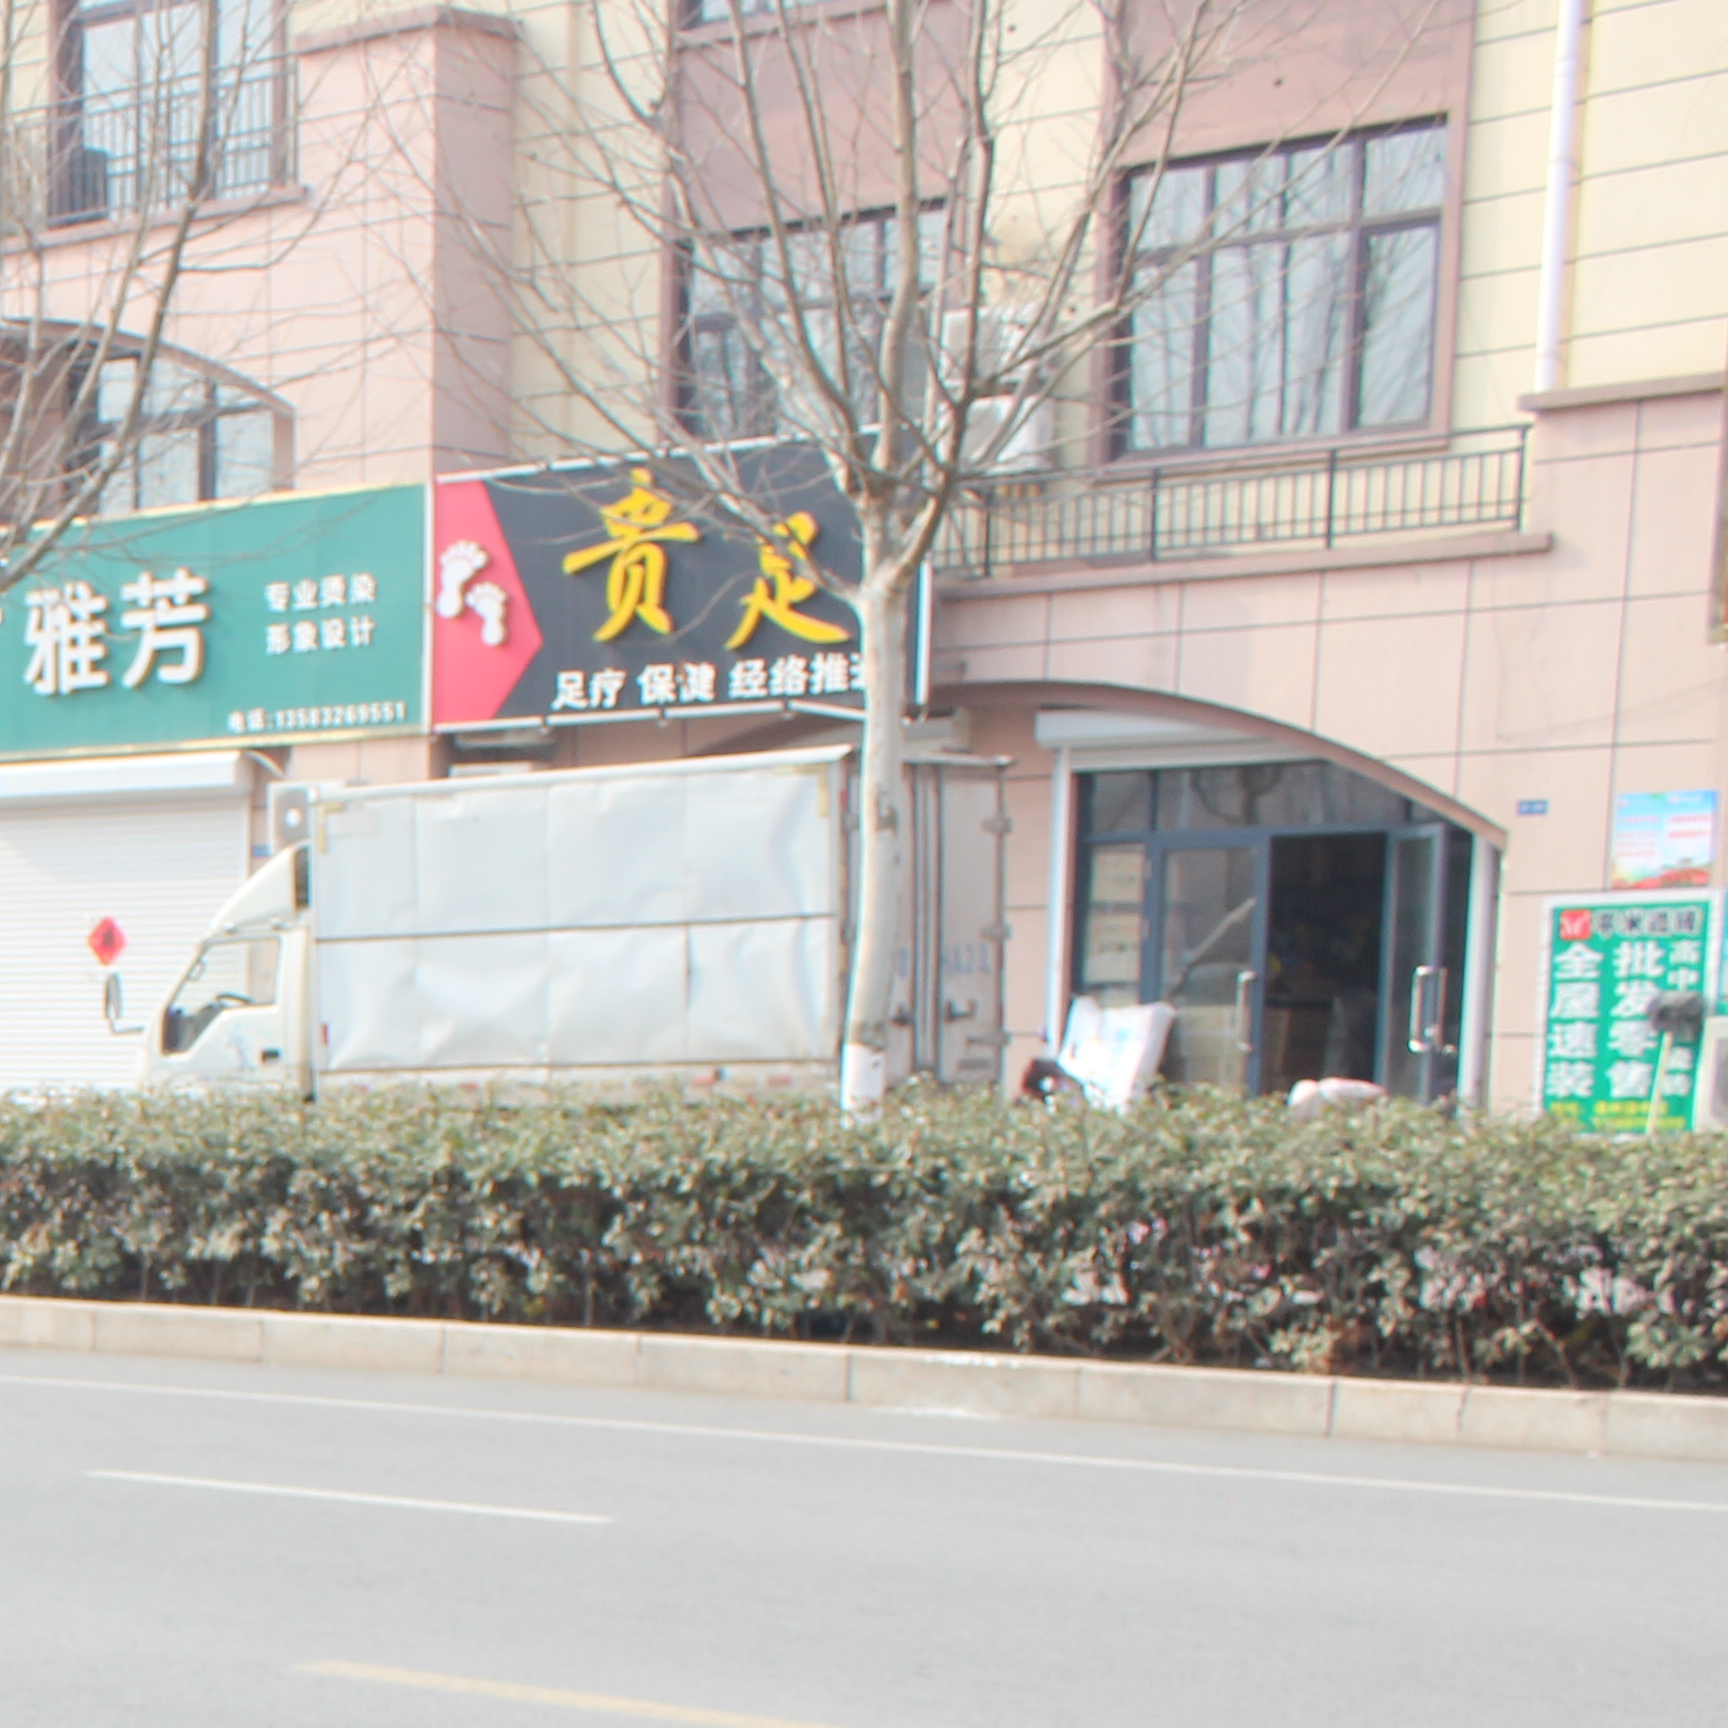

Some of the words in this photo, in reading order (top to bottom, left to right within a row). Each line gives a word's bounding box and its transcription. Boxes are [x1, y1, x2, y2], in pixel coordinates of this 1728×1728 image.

[264, 572, 377, 613] 专业烫染
[562, 468, 850, 650] 贵足
[23, 567, 209, 695] 雅芳
[265, 615, 376, 655] 形象设计
[551, 668, 626, 711] 足疗
[1606, 942, 1664, 1099] 批发零售
